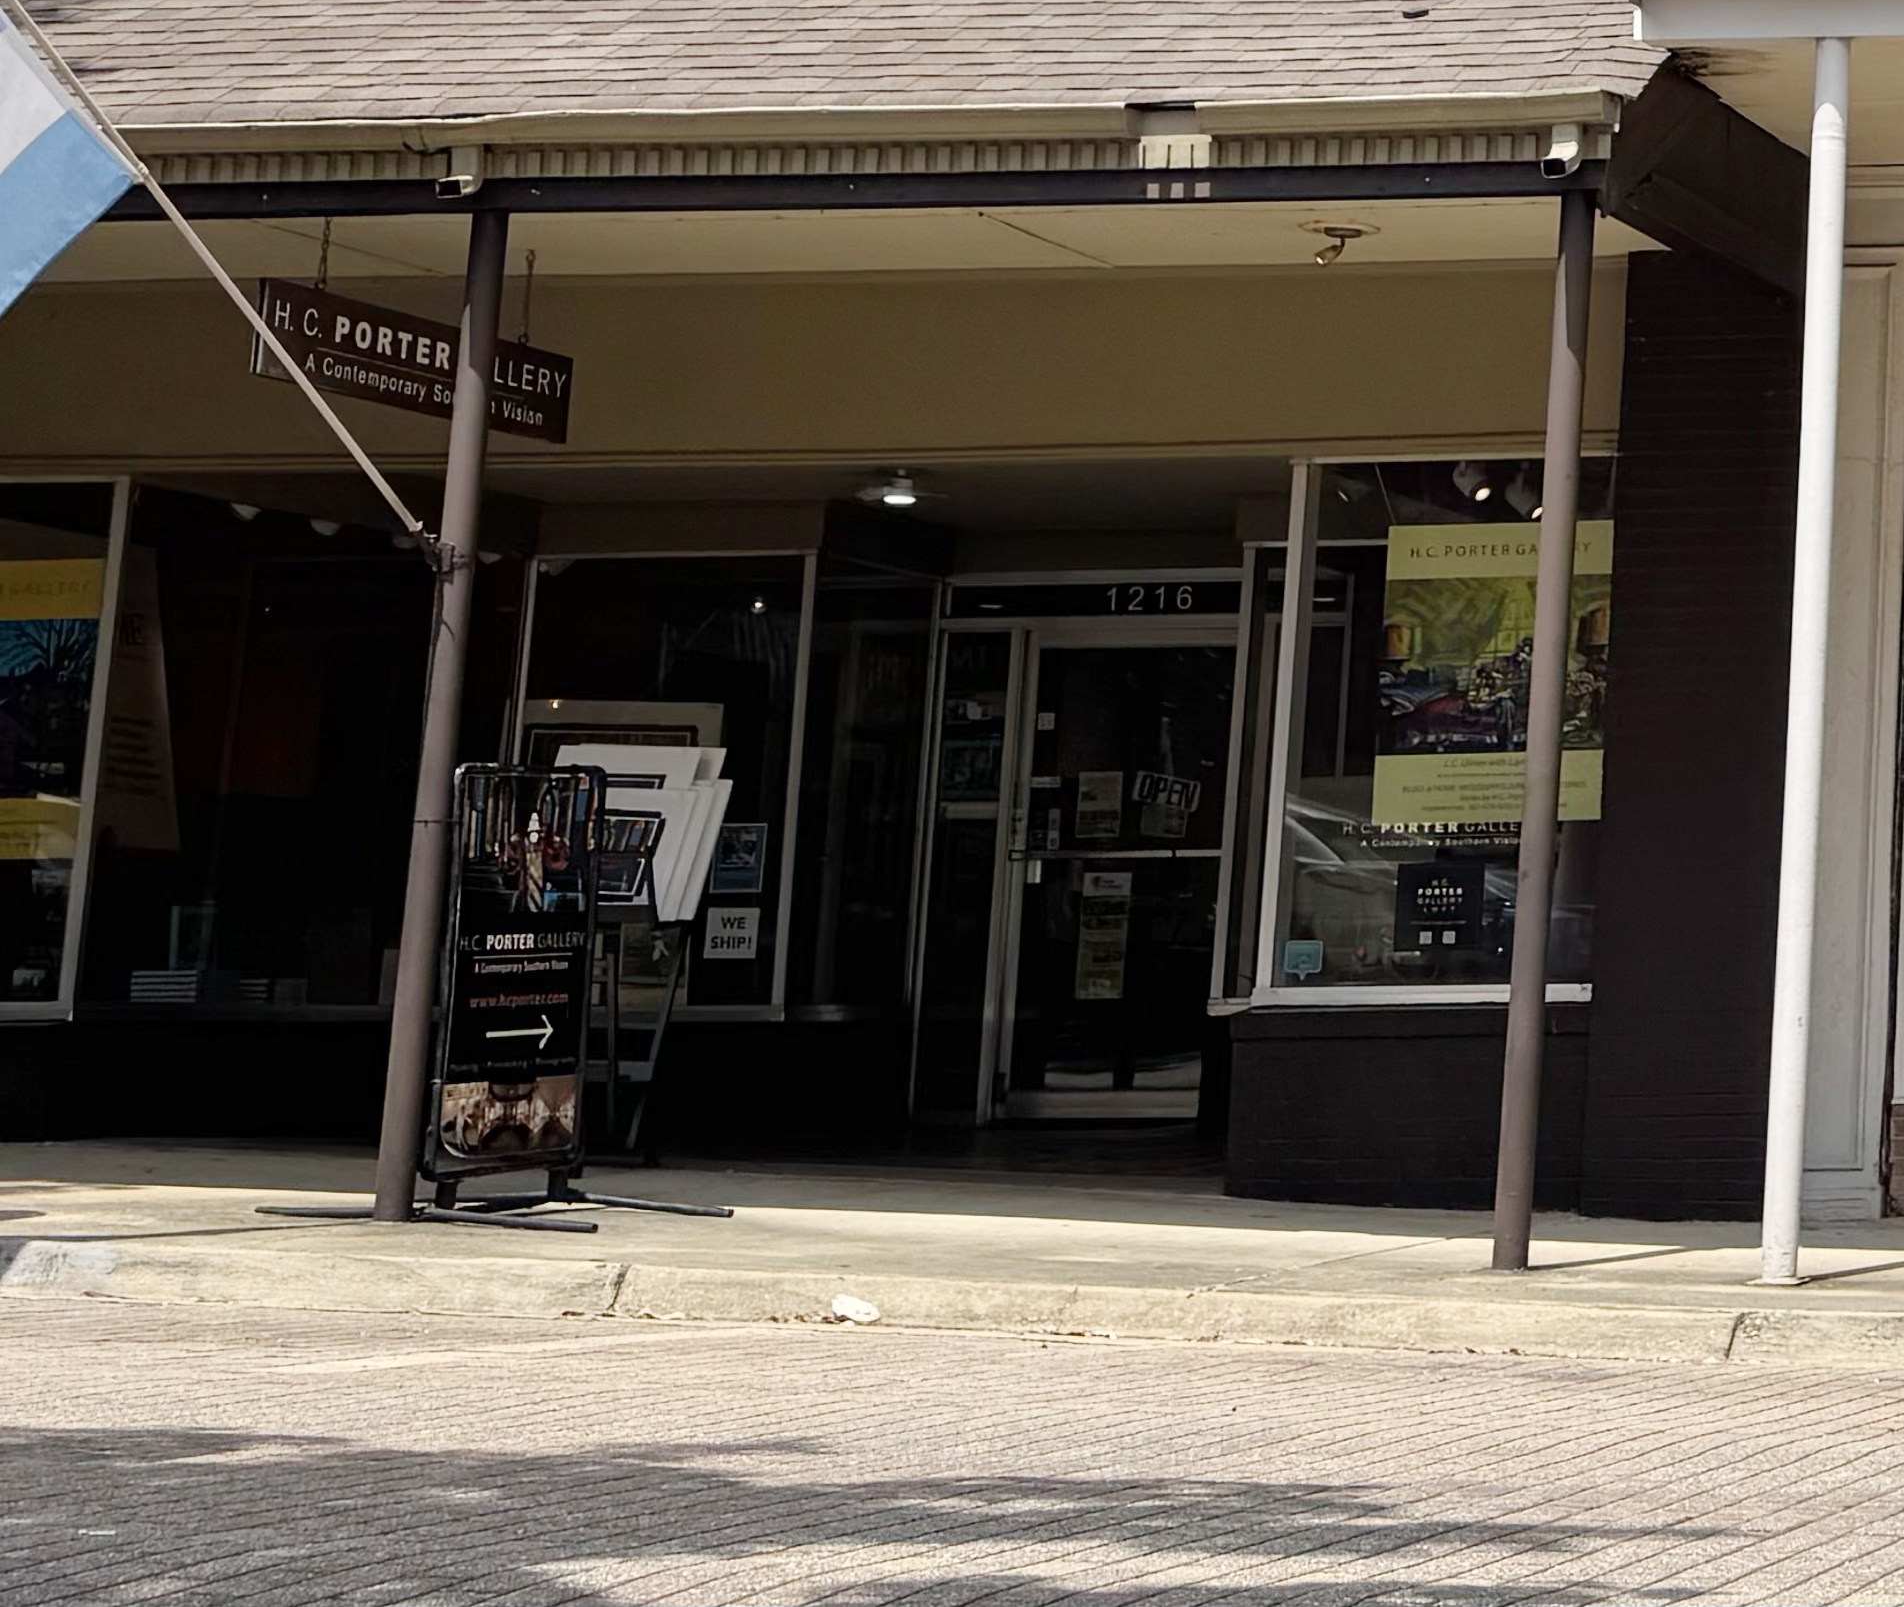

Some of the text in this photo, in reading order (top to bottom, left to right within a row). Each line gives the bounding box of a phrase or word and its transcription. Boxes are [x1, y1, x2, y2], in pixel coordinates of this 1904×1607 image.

[334, 314, 451, 371] PORTER
[493, 356, 567, 398] LLERY
[304, 352, 316, 373] A
[322, 356, 427, 403] Contemporary
[502, 400, 544, 427] Vision
[1444, 544, 1510, 558] PORTER
[1106, 585, 1193, 612] 1216
[1138, 773, 1198, 810] OPEN
[1380, 821, 1459, 834] PORTER
[1464, 820, 1521, 833] GALLE
[1494, 835, 1521, 845] Visio
[721, 916, 746, 930] WE
[486, 933, 535, 951] PORTER
[537, 931, 586, 949] GALLERY
[710, 935, 752, 950] SHIP!
